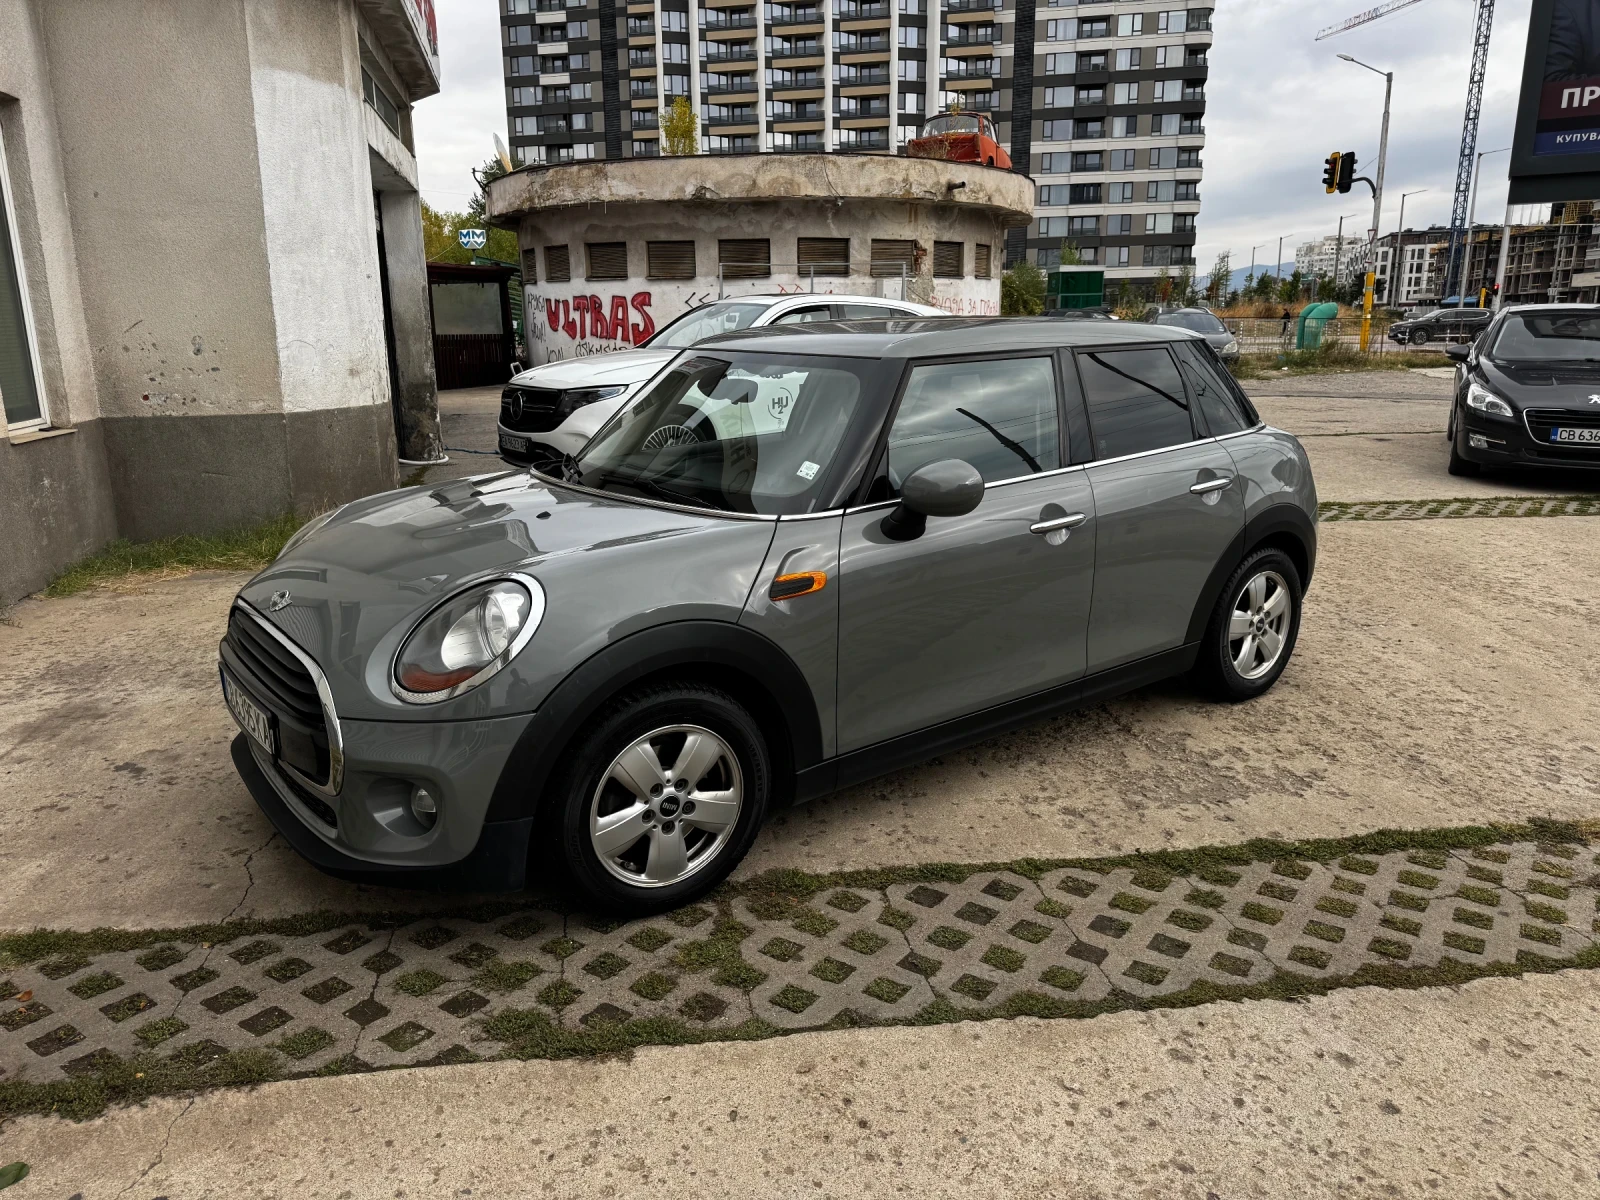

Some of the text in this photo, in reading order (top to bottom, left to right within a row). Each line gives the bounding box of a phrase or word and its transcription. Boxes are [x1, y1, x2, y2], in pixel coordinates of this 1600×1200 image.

[1556, 132, 1600, 143] КУПУВ
[545, 292, 655, 346] ULTRAS
[1578, 430, 1600, 442] 636
